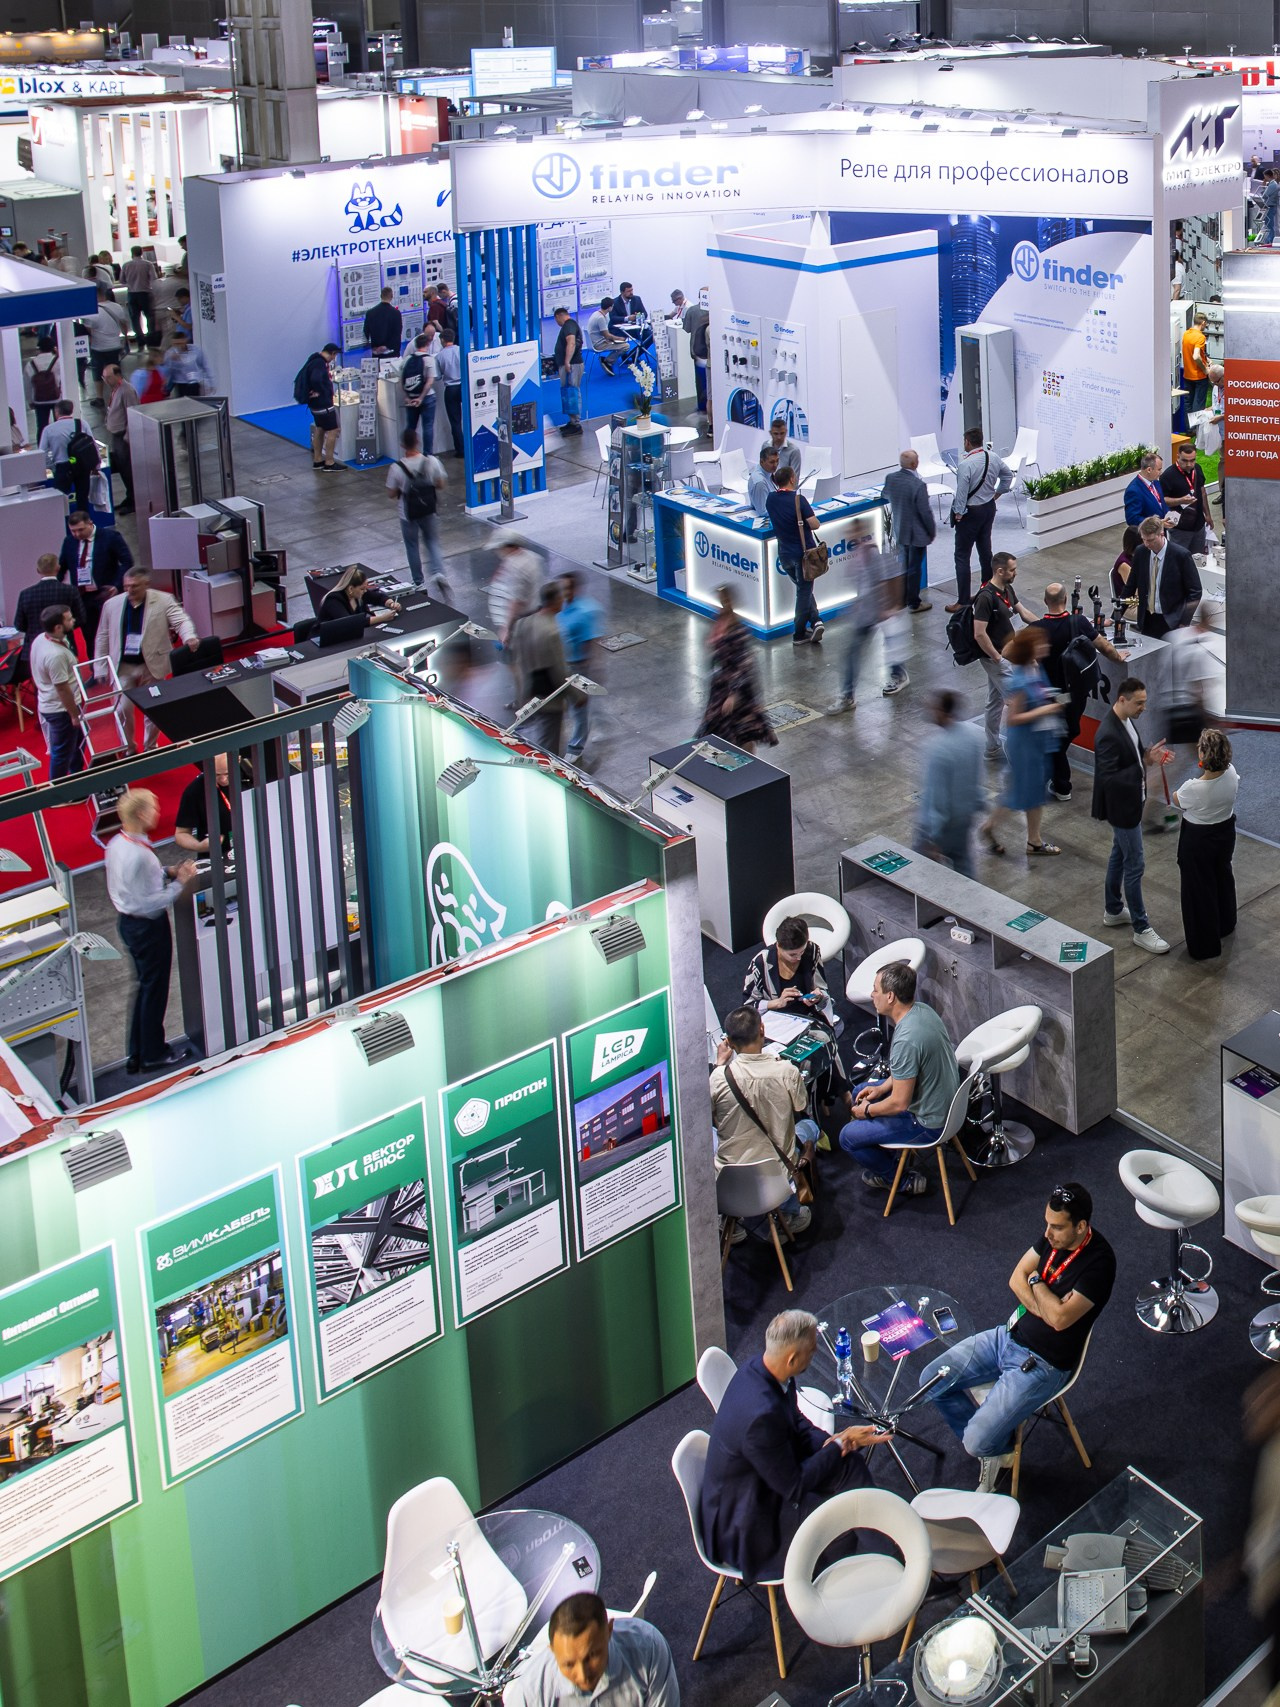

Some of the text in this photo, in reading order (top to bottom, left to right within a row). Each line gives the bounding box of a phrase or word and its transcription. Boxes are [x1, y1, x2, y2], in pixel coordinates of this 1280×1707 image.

[19, 77, 125, 94] blox & KART
[590, 161, 739, 190] finder
[840, 158, 1129, 185] Реле для профессионалов
[1195, 161, 1241, 179] ЭЛЕКТРО
[592, 189, 741, 204] RELAYING INNOVATION
[292, 229, 452, 263] #ЭЛЕКТРОТЕХНИЧЕСК
[1043, 258, 1124, 290] finder
[1044, 283, 1067, 293] SWITCH
[1080, 289, 1091, 297] THE
[1093, 290, 1116, 301] FUTURE
[1082, 380, 1100, 391] Finder
[1105, 386, 1121, 396] мире
[1236, 450, 1255, 458] 2010
[1256, 451, 1279, 459] ГОДА
[711, 543, 759, 573] finder
[712, 560, 760, 583] RELAYING INNOVATION
[601, 1048, 634, 1068] LAMPICA
[494, 1077, 547, 1110] ПРОТОН
[363, 1133, 415, 1166] ВЕКТОР
[363, 1149, 406, 1176] ПЛЮС
[172, 1207, 271, 1258] ВИМКАБЕЛЬ
